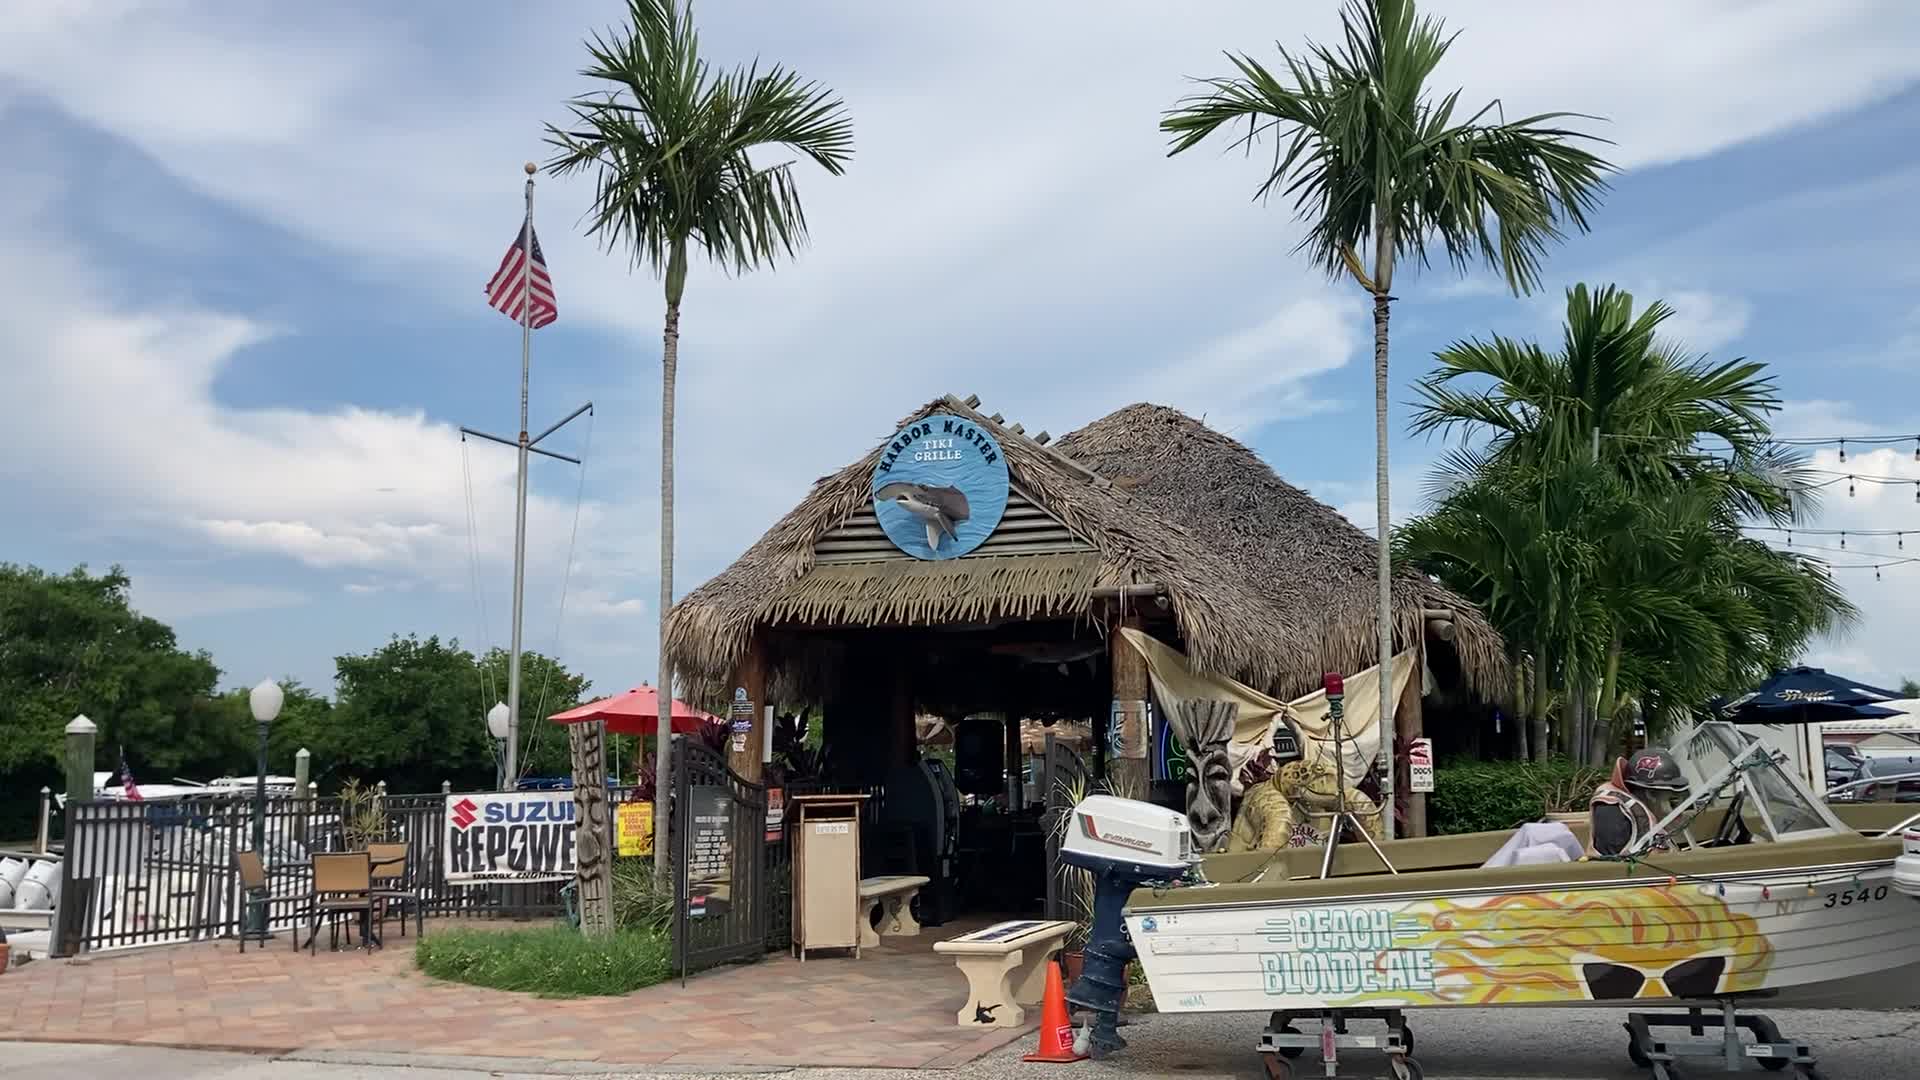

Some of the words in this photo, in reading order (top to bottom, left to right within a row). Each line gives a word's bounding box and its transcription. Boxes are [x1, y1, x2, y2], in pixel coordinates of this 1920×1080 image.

[879, 423, 932, 472] HARBOR
[943, 420, 997, 465] MASTER
[914, 449, 962, 462] GRILLE
[922, 439, 953, 450] TIKI
[484, 800, 576, 823] SUZU
[451, 824, 577, 873] REPOWE
[1823, 885, 1888, 908] 3540
[1291, 907, 1392, 950] BEACH
[1259, 951, 1380, 994] BLONDE
[1386, 950, 1436, 991] ALE
